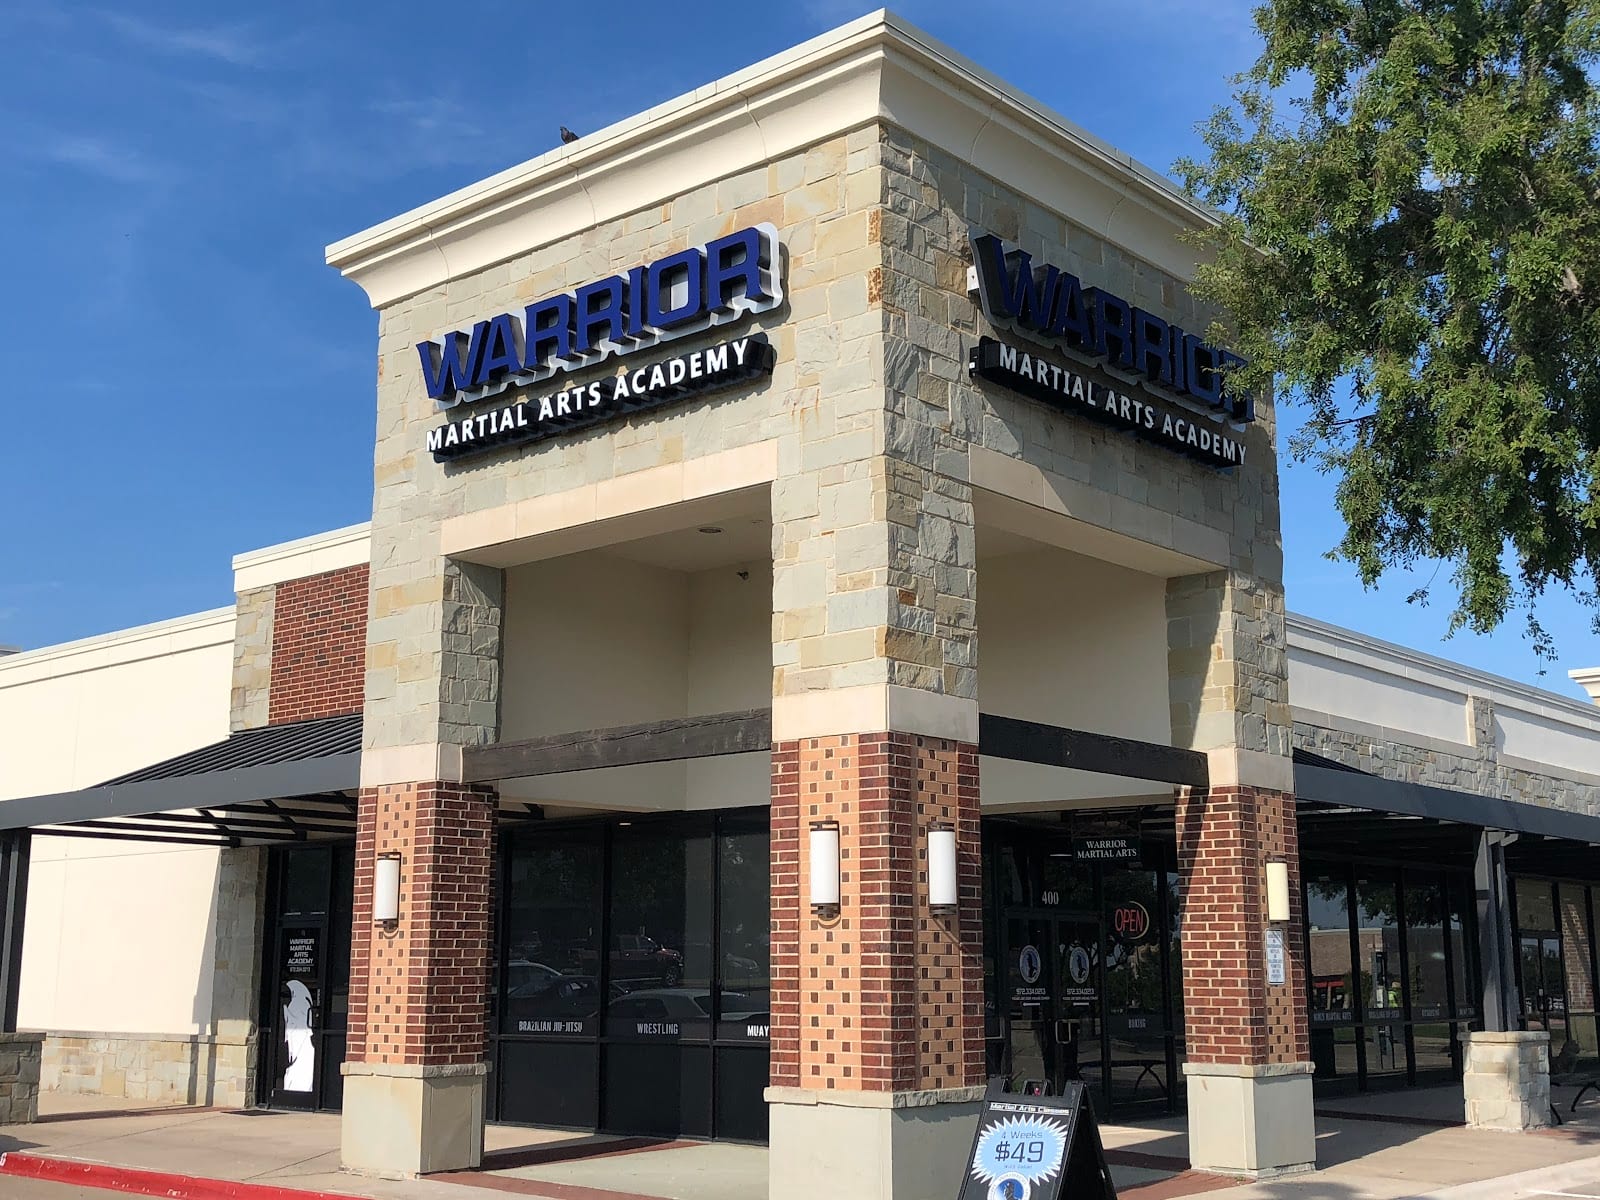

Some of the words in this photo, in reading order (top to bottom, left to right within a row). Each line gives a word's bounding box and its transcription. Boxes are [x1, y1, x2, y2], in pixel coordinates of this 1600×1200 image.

[416, 225, 770, 404] WARRIOR
[426, 409, 528, 454] MARTIAL
[538, 382, 601, 421] ARTS
[613, 338, 749, 401] ACADEMY
[999, 343, 1097, 407] MARTIAL
[1105, 390, 1155, 429] ARTS
[1162, 414, 1247, 465] ACADEMY
[1086, 839, 1127, 849] WARRIOR
[1077, 849, 1115, 859] MARTIAL
[1115, 848, 1137, 857] ARTS
[1041, 891, 1059, 905] 400
[1114, 908, 1144, 932] OPEN
[519, 1020, 552, 1032] BRAZILIAN
[553, 1021, 583, 1033] JIU-JITSU
[637, 1023, 679, 1035] WRESTLING
[747, 1025, 770, 1037] MUAY
[1011, 1130, 1043, 1139] Weeks
[995, 1140, 1045, 1163] $49
